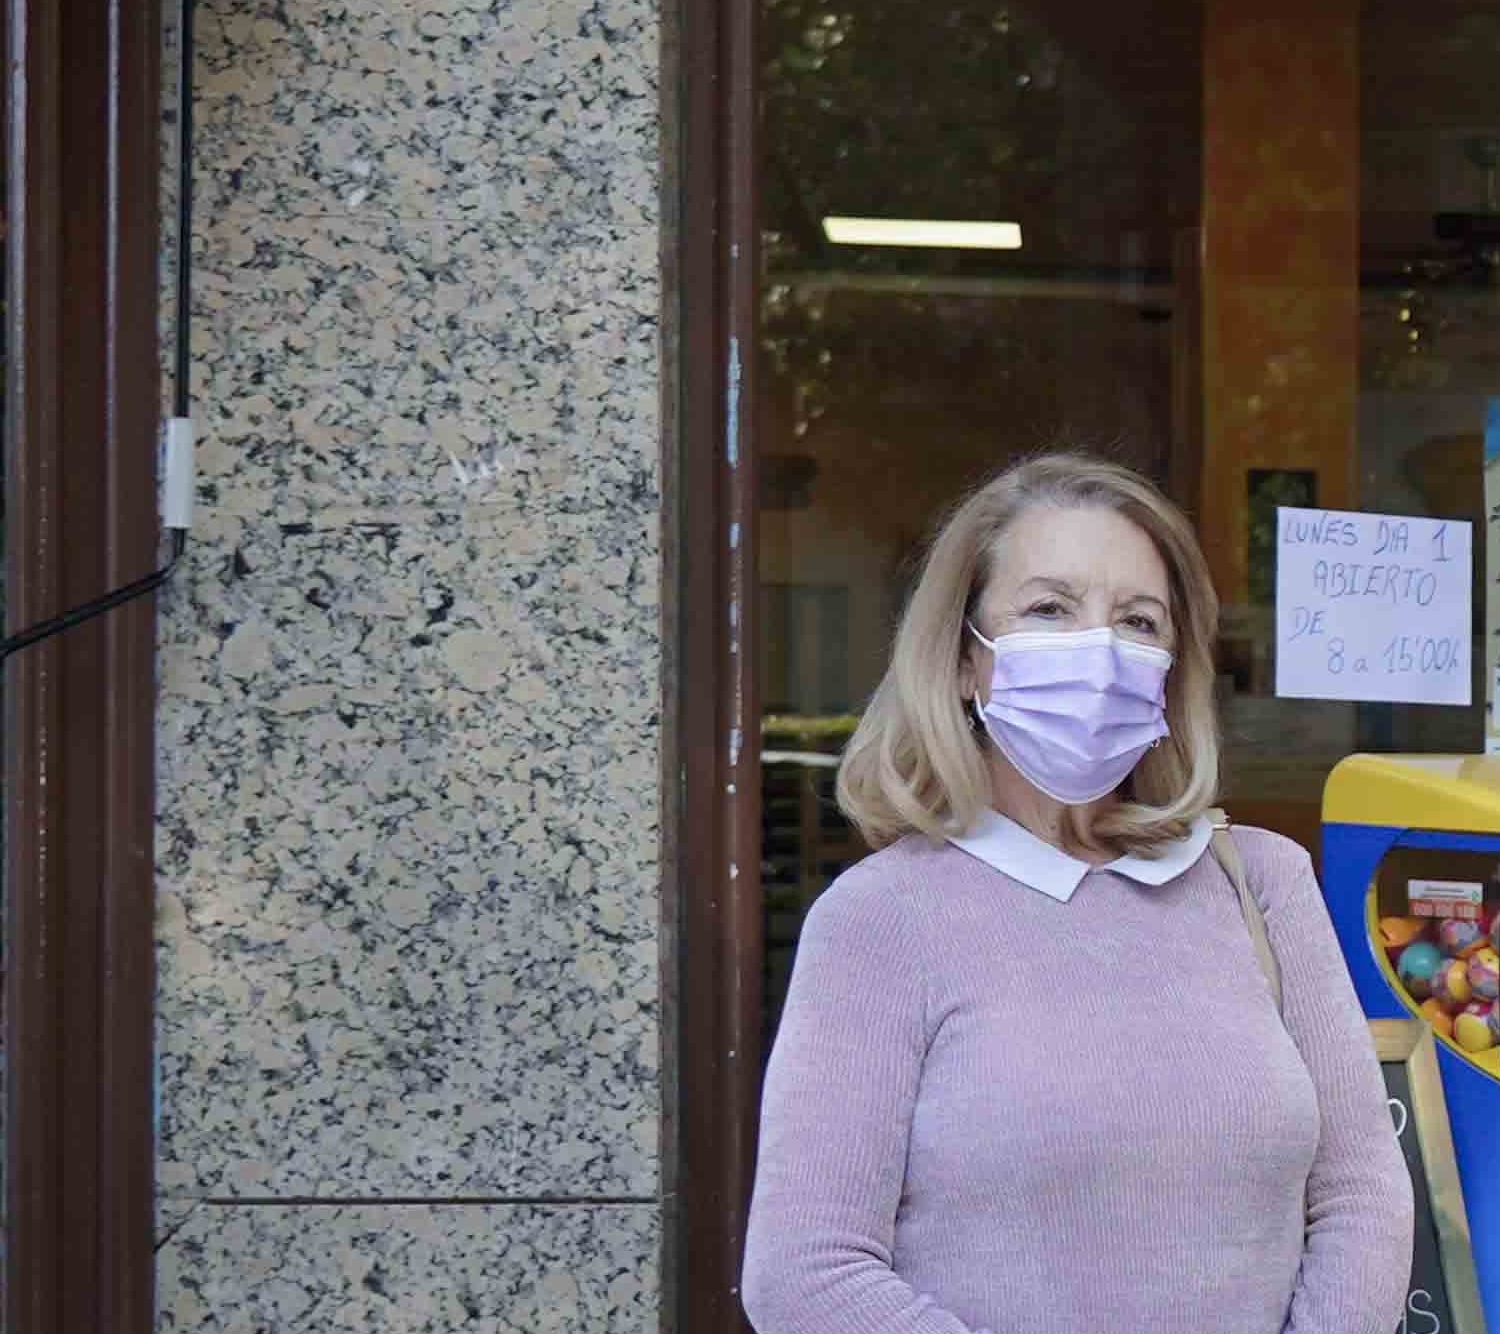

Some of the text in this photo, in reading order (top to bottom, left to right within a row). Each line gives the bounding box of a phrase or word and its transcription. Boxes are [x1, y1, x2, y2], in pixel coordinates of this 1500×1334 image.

[1283, 513, 1359, 547] LUNES
[1432, 523, 1453, 562] 1
[1313, 559, 1437, 607] ABIERTO
[1288, 605, 1325, 643] DE
[1327, 636, 1346, 675] 8
[1353, 658, 1369, 674] a
